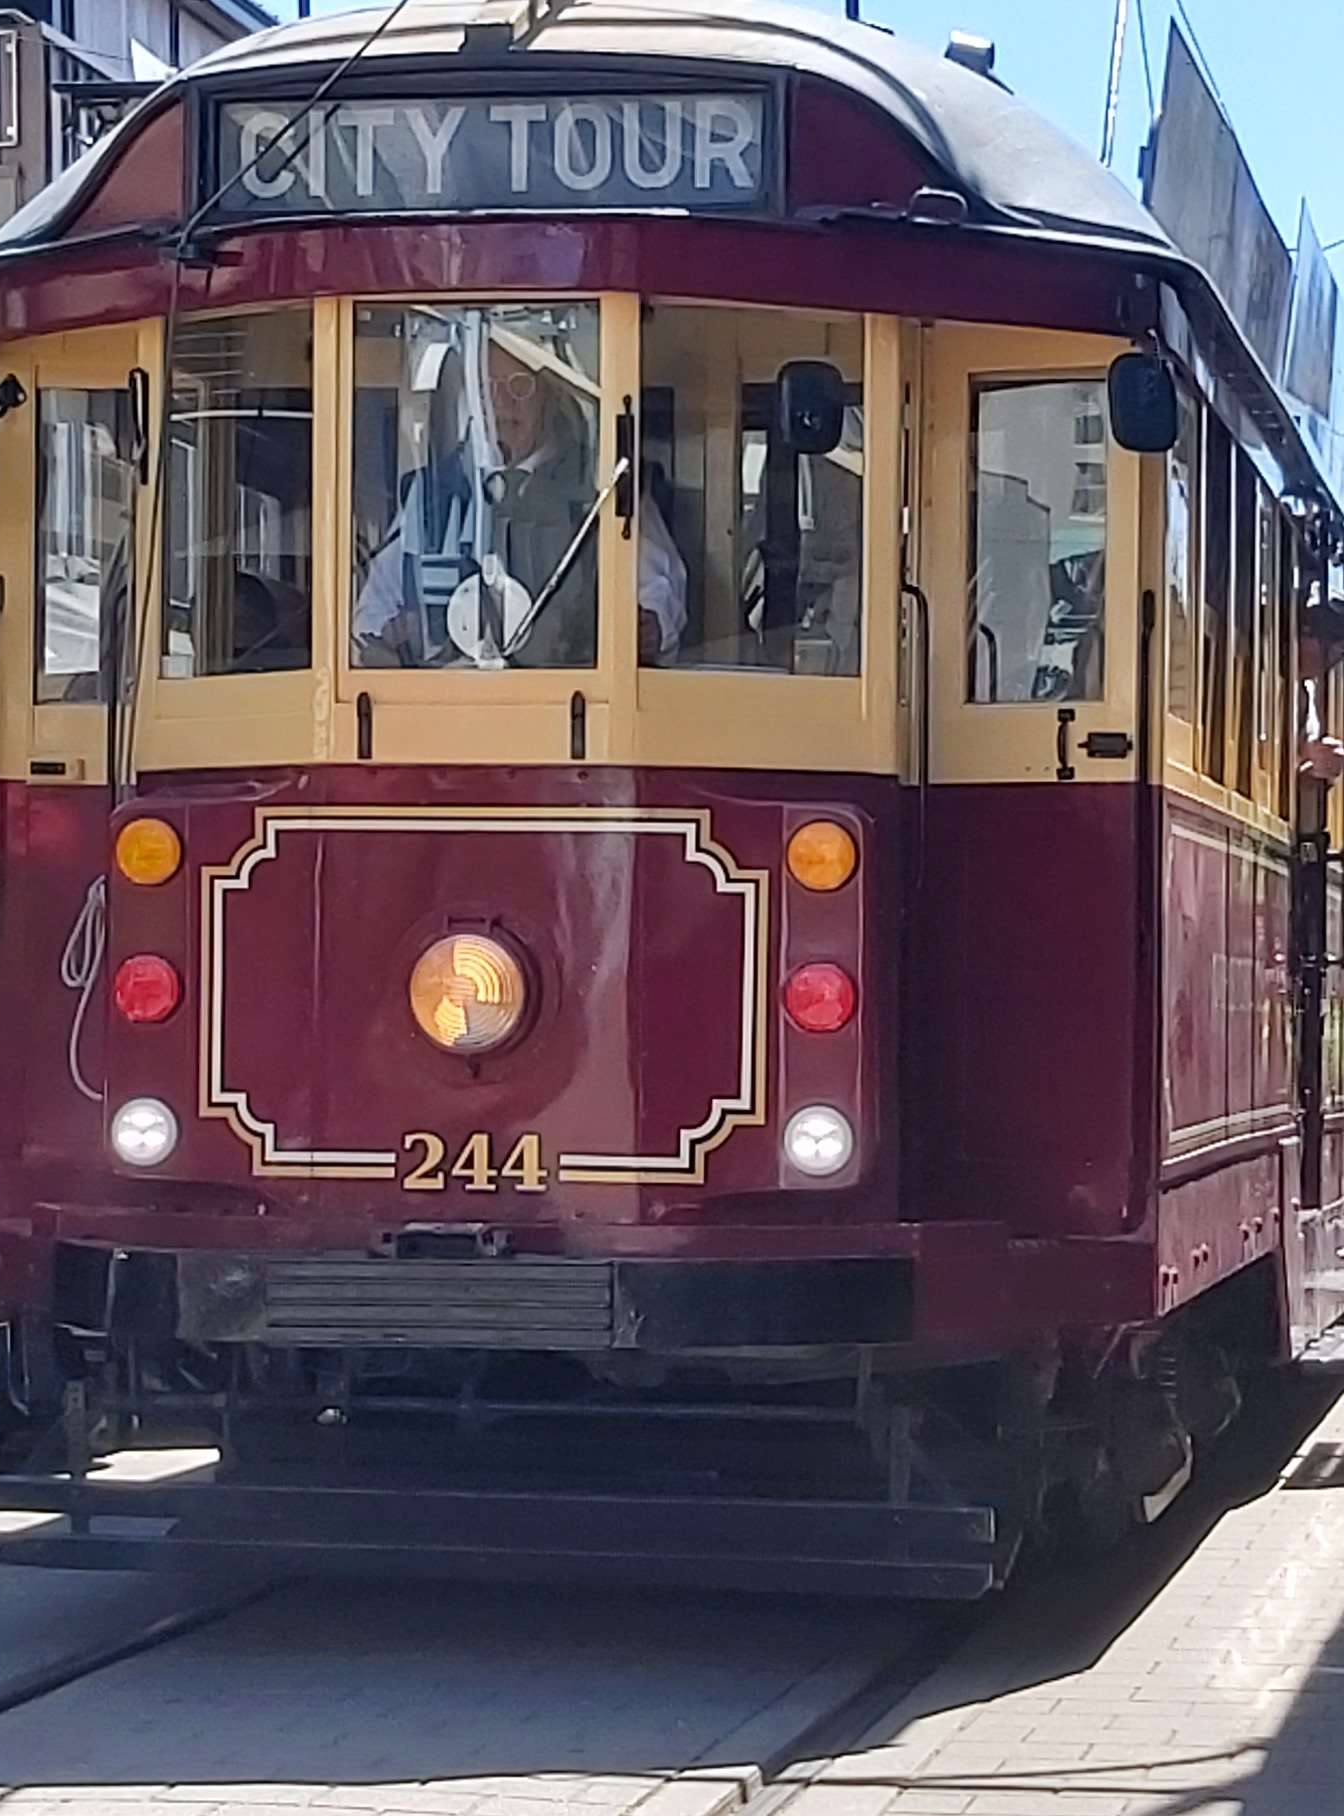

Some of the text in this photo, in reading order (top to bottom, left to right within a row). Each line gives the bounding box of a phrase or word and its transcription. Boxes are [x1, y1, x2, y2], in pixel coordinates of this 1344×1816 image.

[239, 98, 755, 198] CITY TOUR
[403, 1132, 548, 1191] 244
